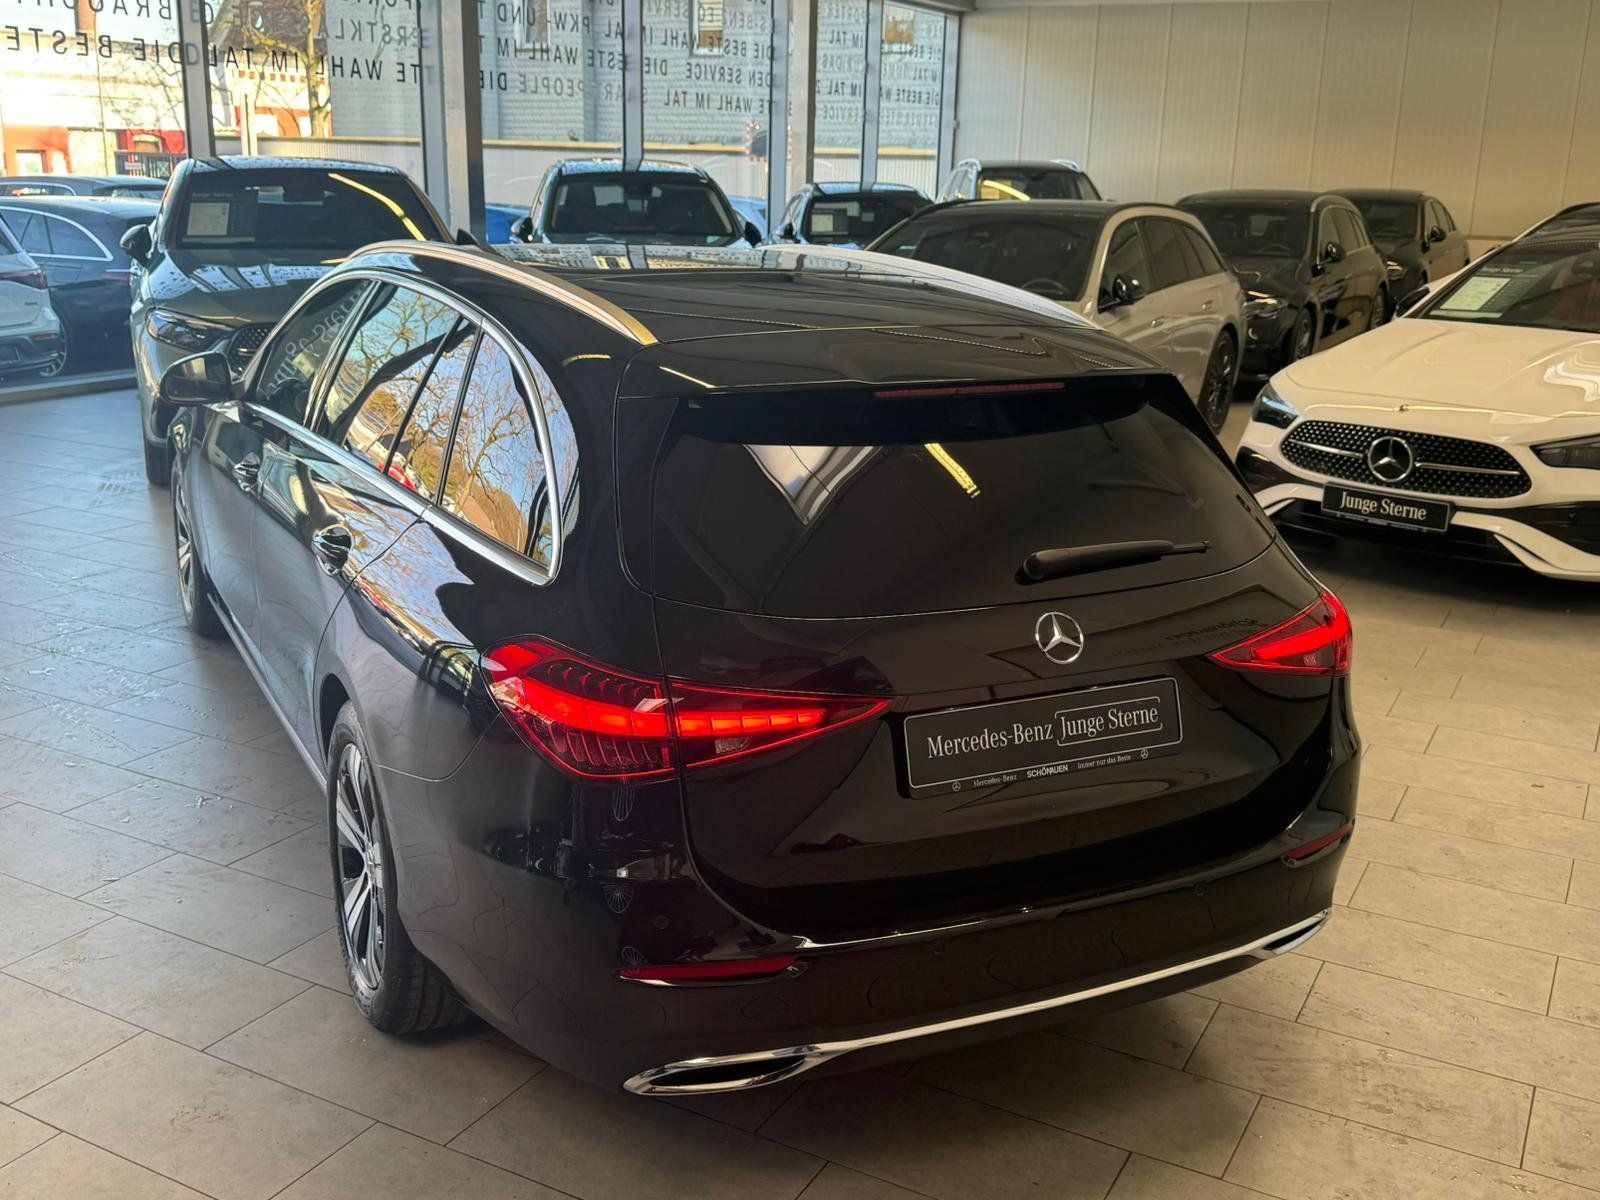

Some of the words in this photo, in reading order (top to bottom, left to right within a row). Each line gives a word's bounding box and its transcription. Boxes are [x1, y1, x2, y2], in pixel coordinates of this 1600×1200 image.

[1340, 491, 1377, 514] Junge
[1380, 498, 1427, 520] Sterne
[927, 722, 1053, 758] Mercedes-Benz
[1060, 714, 1104, 740] Junge
[1108, 707, 1159, 730] Sterne
